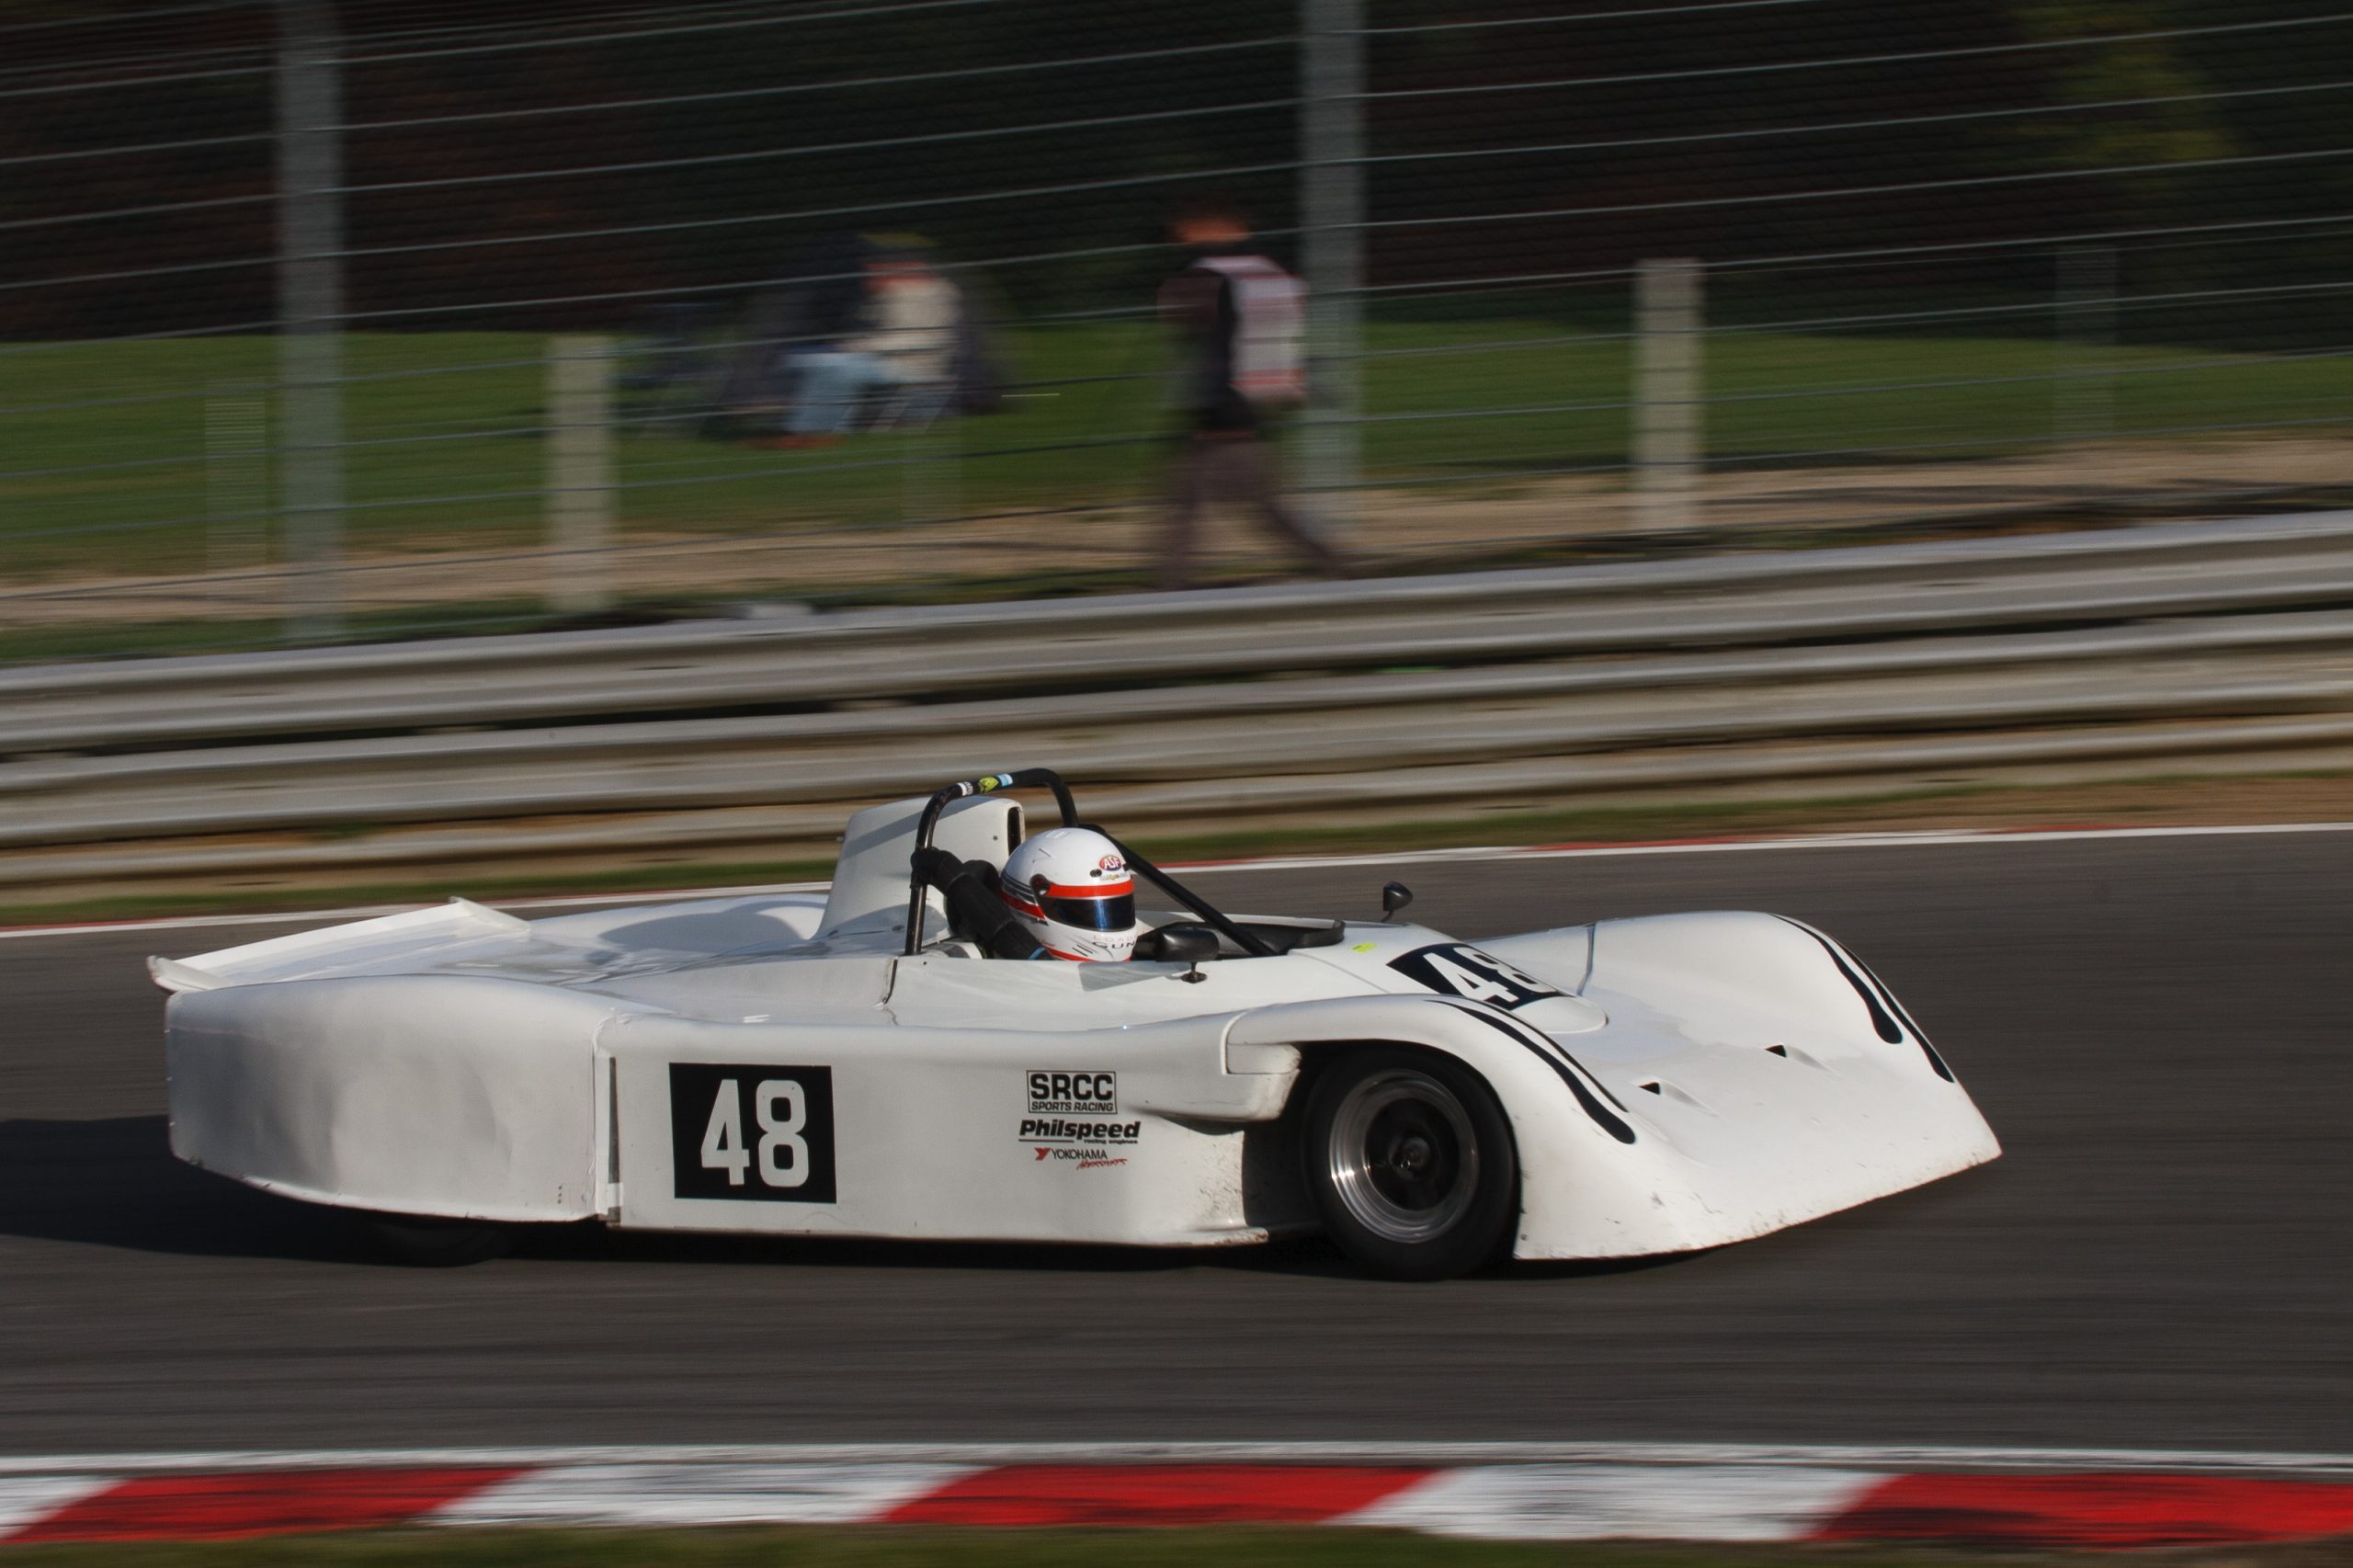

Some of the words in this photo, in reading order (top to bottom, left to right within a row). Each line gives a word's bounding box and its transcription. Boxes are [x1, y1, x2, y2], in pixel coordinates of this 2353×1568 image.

[1423, 946, 1560, 1003] 48
[1030, 1074, 1113, 1101] SRCC
[1031, 1101, 1072, 1111] SPORTS
[1074, 1102, 1114, 1112] RACING
[700, 1078, 810, 1187] 48
[1019, 1119, 1142, 1140] Philspeed
[1051, 1149, 1108, 1160] YOKOHAMA
